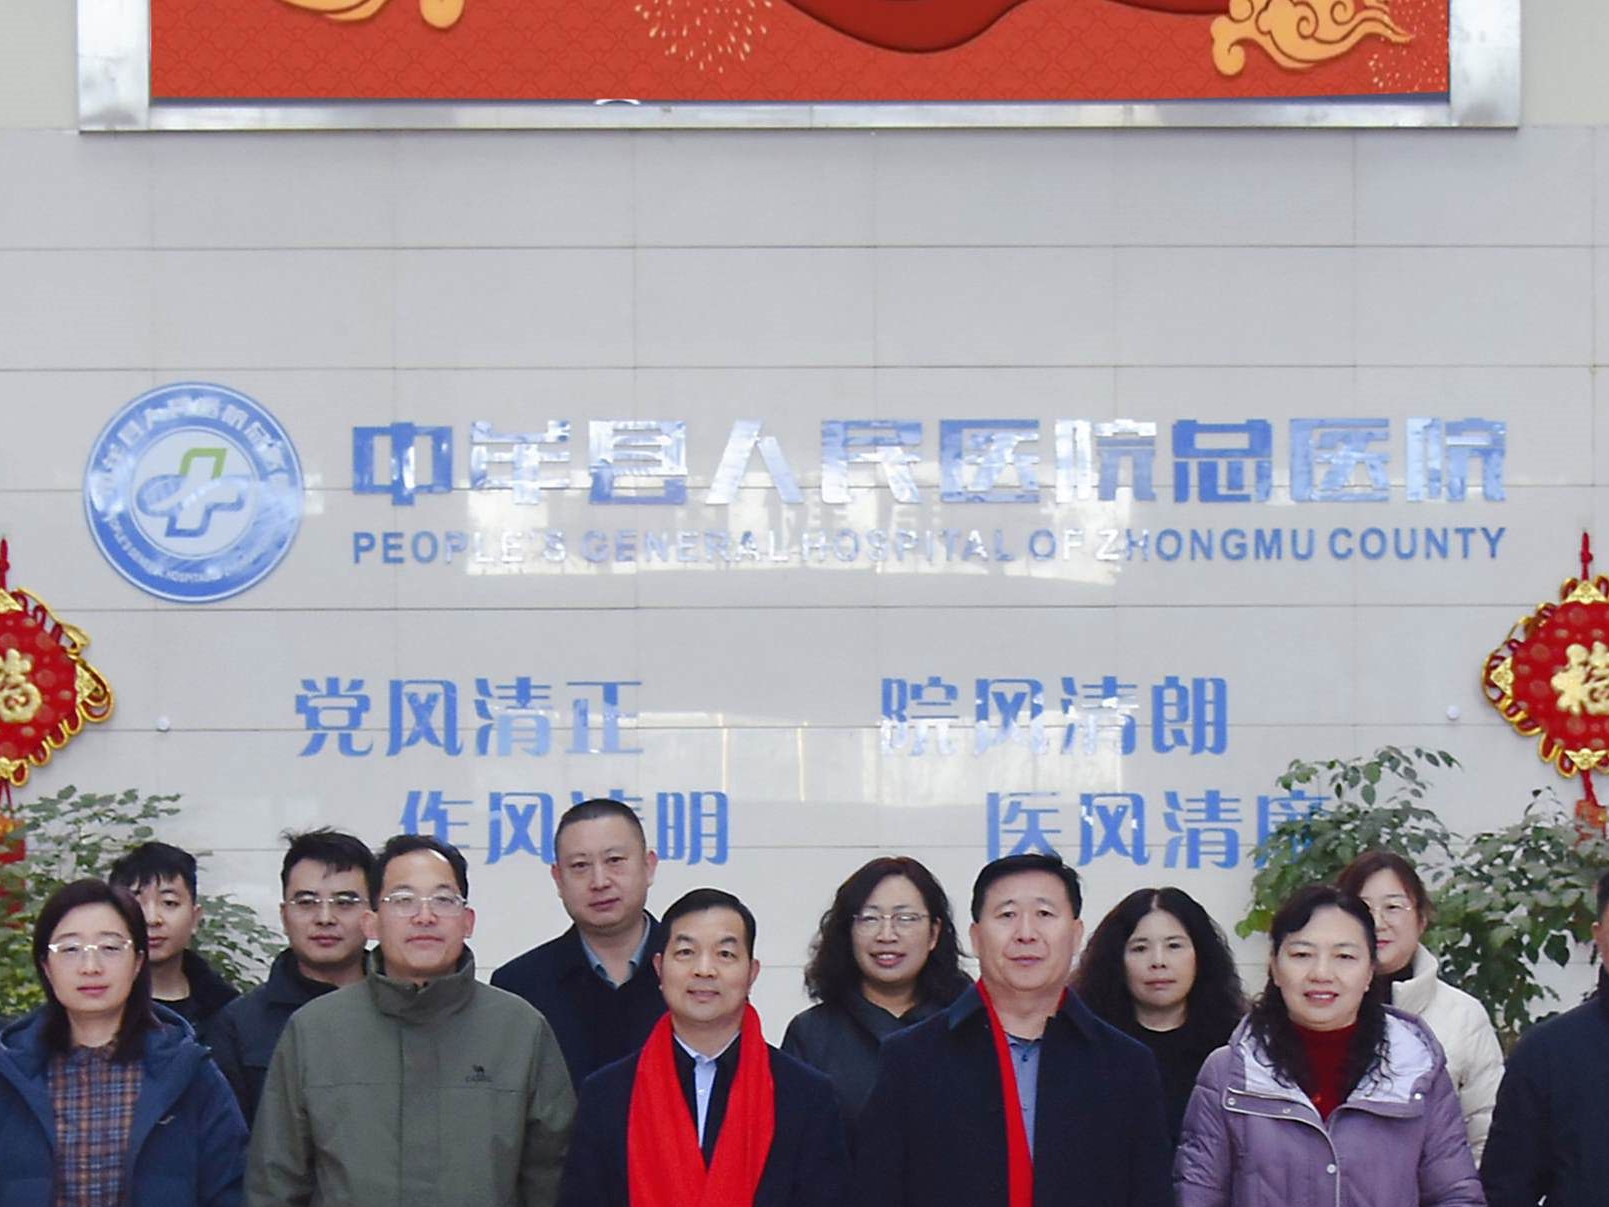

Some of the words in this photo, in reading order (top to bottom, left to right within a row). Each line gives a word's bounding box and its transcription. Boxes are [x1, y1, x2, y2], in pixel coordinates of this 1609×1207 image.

[352, 419, 1506, 506] 中牟县人民医院总医院
[353, 530, 567, 564] PEOPLE'S
[582, 529, 788, 564] GENERAL
[802, 528, 1013, 561] HOSPITAL
[1028, 528, 1082, 561] OF
[1095, 527, 1315, 561] ZHONGMU
[1330, 526, 1507, 561] COUNTY
[294, 676, 645, 758] 党风清正
[877, 675, 1229, 756] 院风清朗
[399, 788, 730, 866] 作风明
